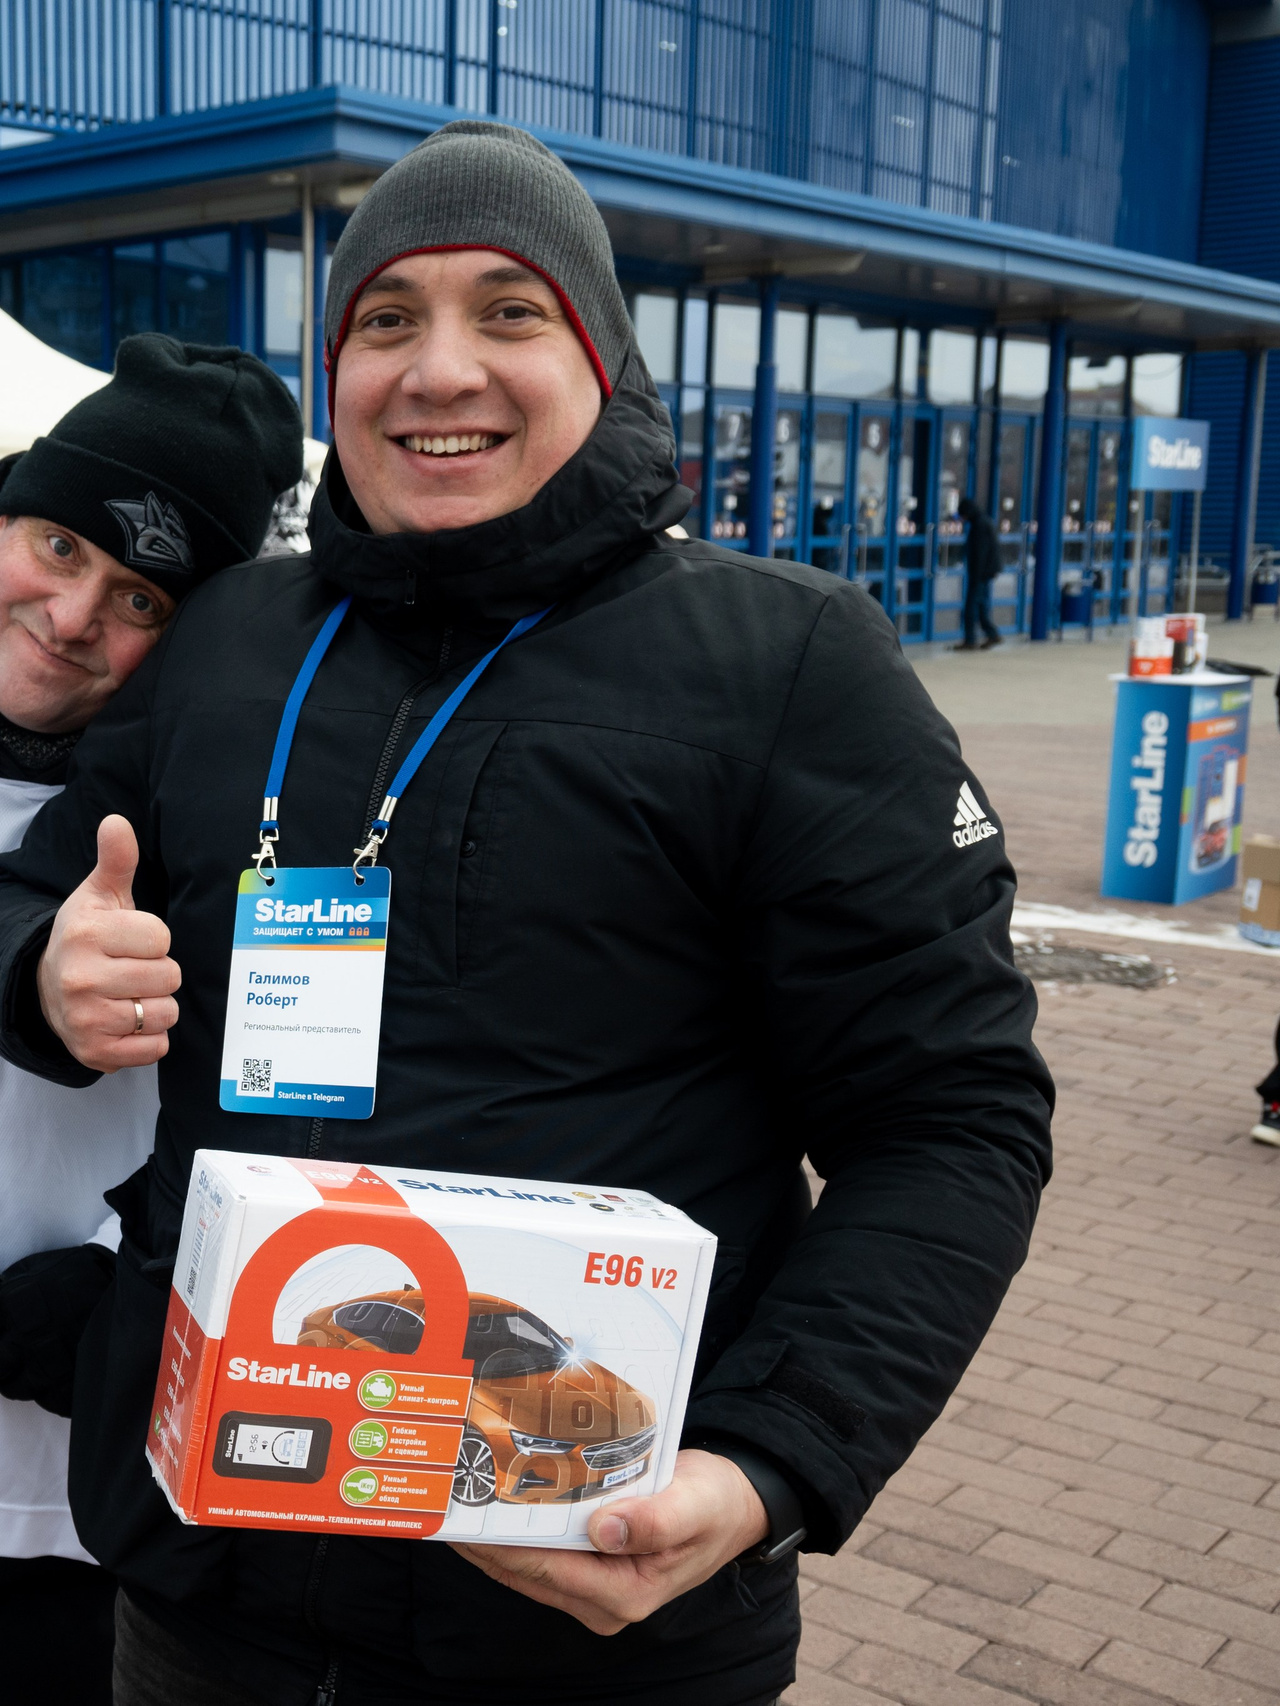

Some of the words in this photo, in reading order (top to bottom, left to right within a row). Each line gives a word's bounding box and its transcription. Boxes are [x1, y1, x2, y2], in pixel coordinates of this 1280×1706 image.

[1148, 434, 1202, 471] StarLine
[1123, 710, 1170, 868] StarLine
[952, 819, 998, 848] adidas
[254, 897, 373, 923] StarLine
[253, 926, 303, 937] ЗАЩИЩАЕТ
[306, 927, 313, 936] С
[317, 927, 344, 936] УМОМ
[248, 971, 310, 985] Галимов
[246, 992, 298, 1009] Роберт
[244, 1022, 300, 1033] Региональный
[302, 1024, 362, 1035] представитель
[277, 1090, 306, 1100] StarLine
[313, 1093, 345, 1103] Telegram
[304, 1170, 353, 1182] E96
[397, 1178, 576, 1205] StarLine
[583, 1252, 644, 1287] E96
[227, 1357, 351, 1390] StarLine
[400, 1383, 424, 1392] Умный
[398, 1394, 459, 1406] климат-контроль
[392, 1426, 417, 1436] Гибкие
[225, 1429, 235, 1458] StarLine
[390, 1437, 427, 1447] настройки
[394, 1448, 428, 1457] сценарии
[383, 1474, 407, 1483] Умный
[607, 1466, 639, 1484] StarLine
[381, 1484, 428, 1495] бесключевой
[379, 1495, 400, 1504] обход
[208, 1506, 234, 1516] УМНЫЙ
[235, 1509, 294, 1521] АВТОМОБИЛЬНЫЙ
[295, 1513, 386, 1527] ОХРАННО-ТЕЛЕМАТИЧЕСКИЙ
[387, 1519, 423, 1530] КОМПЛЕКС
